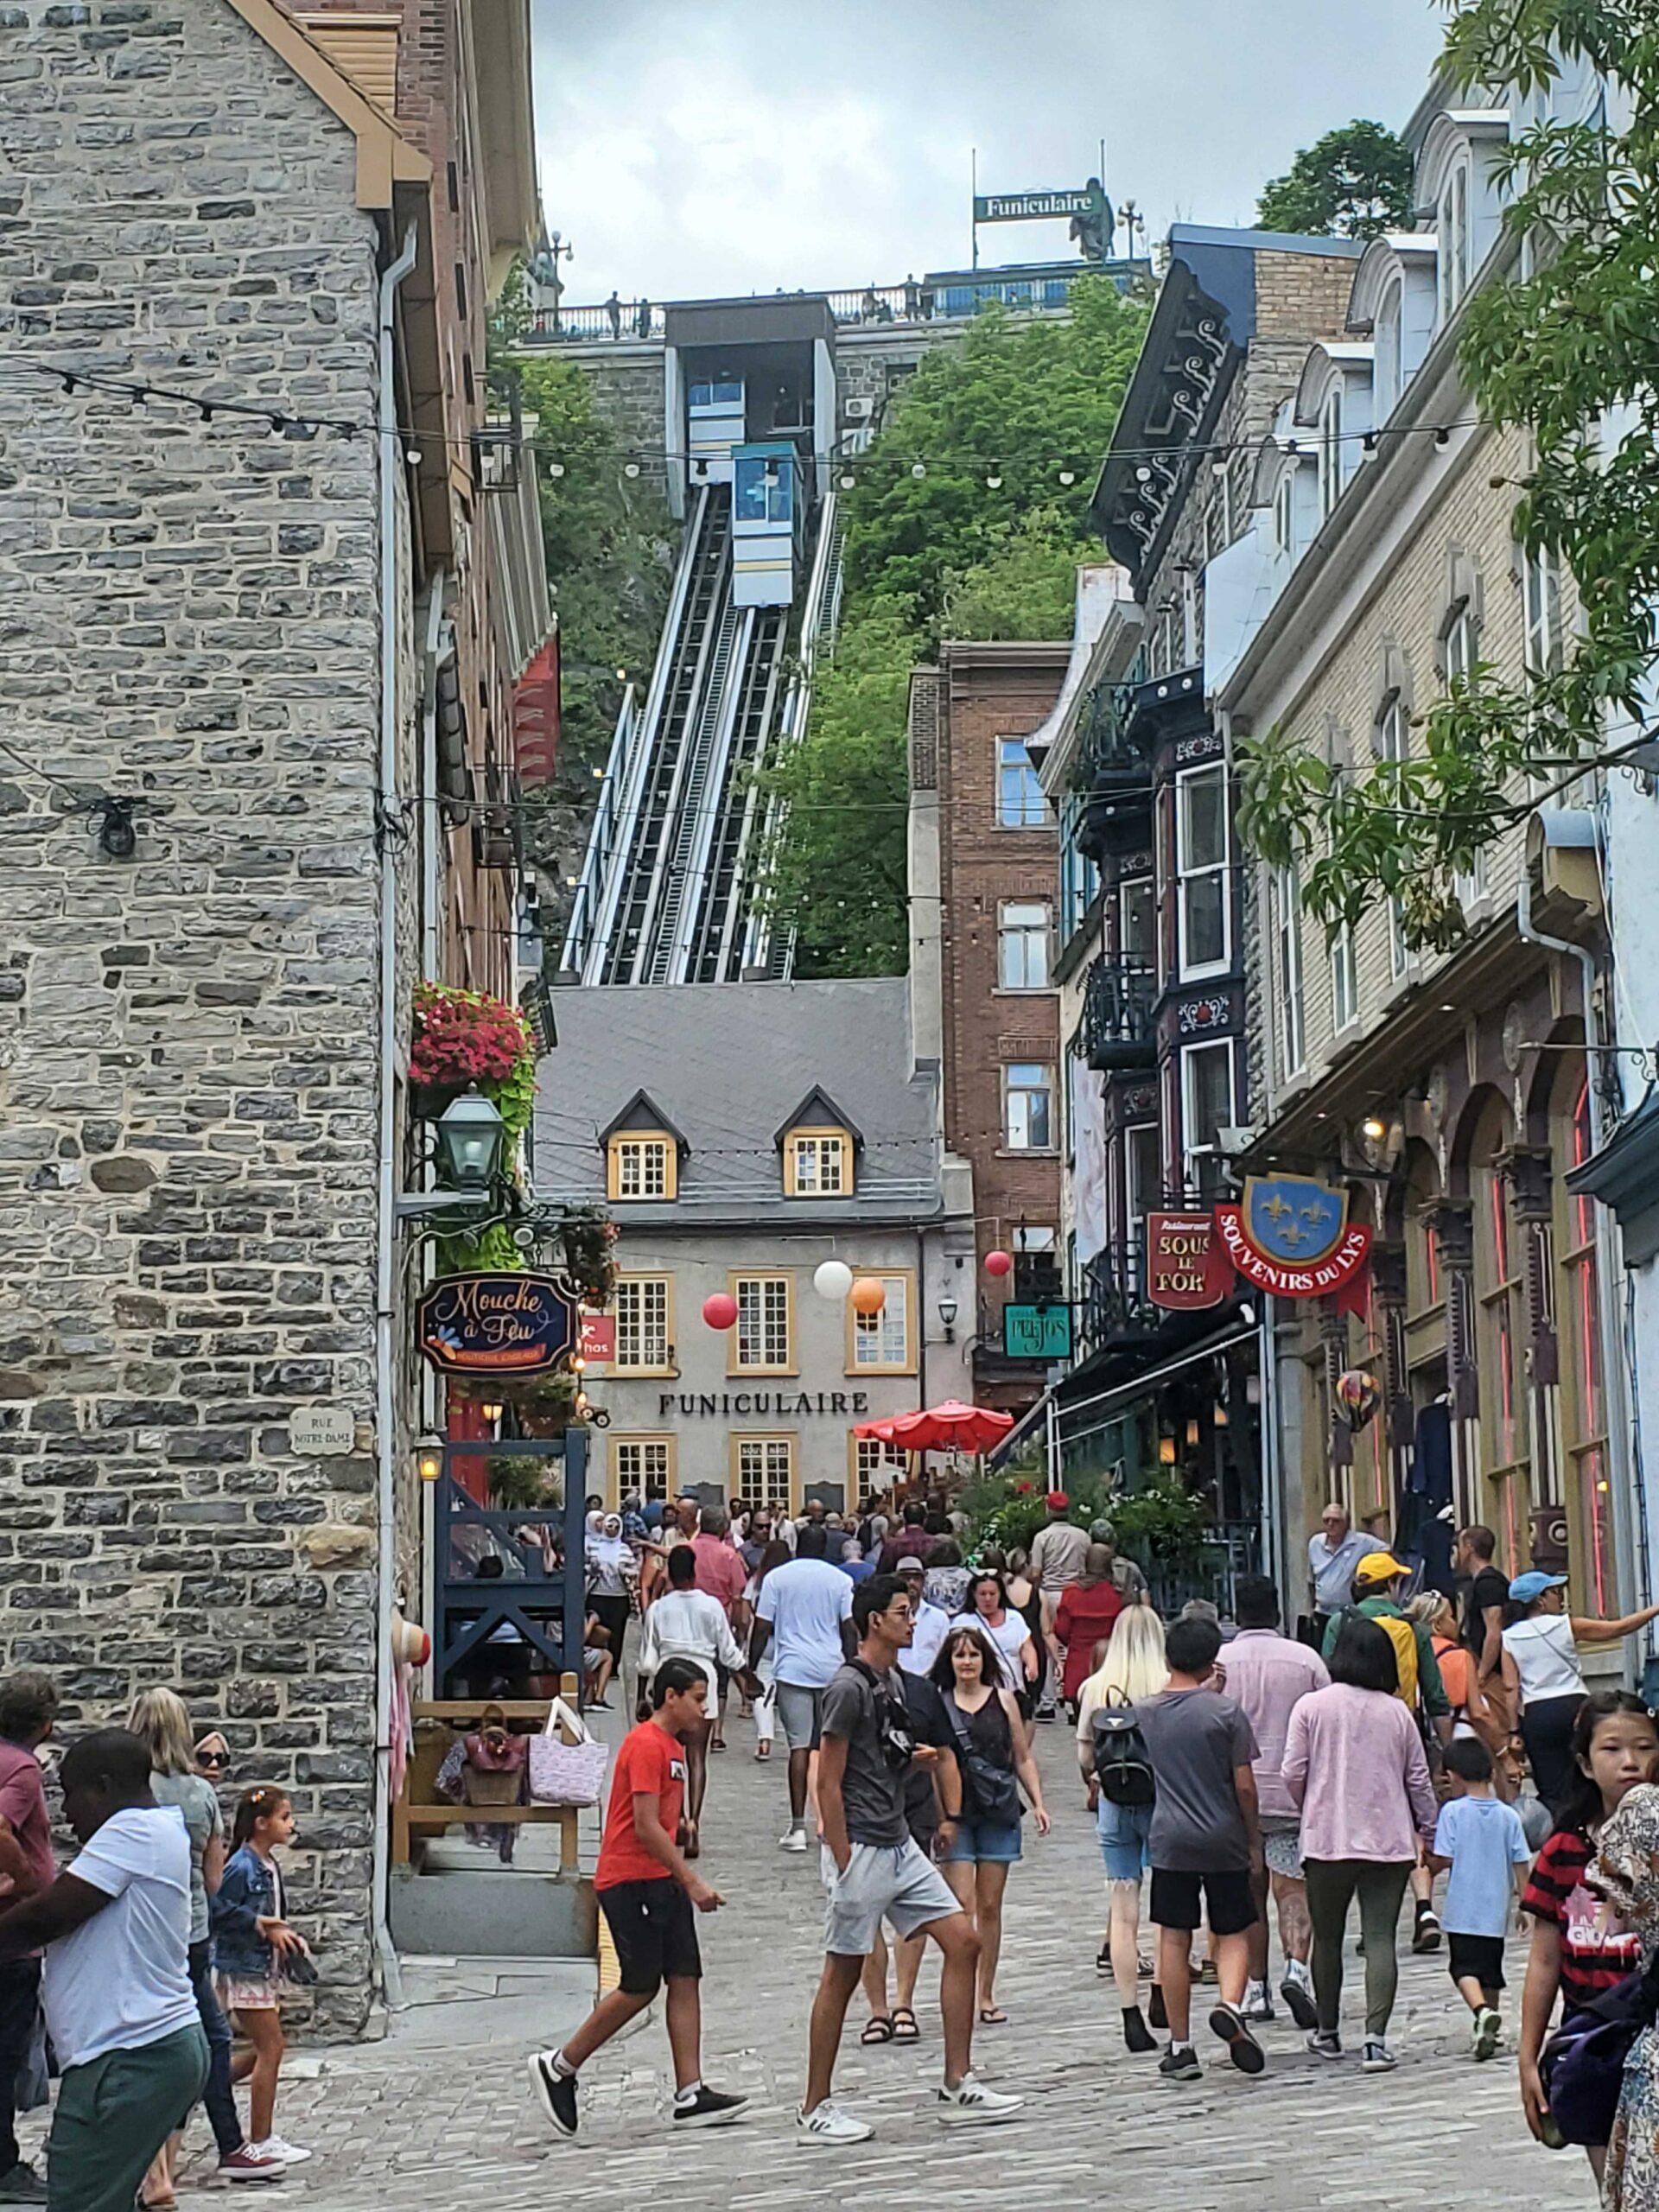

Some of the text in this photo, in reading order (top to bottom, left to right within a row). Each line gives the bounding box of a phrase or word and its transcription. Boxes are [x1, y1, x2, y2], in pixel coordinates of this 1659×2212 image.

[986, 194, 1092, 216] Funiculaire
[1178, 1257, 1195, 1269] LE
[1220, 1214, 1365, 1290] SOUVENIRS DU LYS
[435, 1279, 542, 1321] Mouche
[464, 1319, 478, 1338] à
[658, 1392, 868, 1415] FUNICULAIRE
[311, 1418, 334, 1429] RUE
